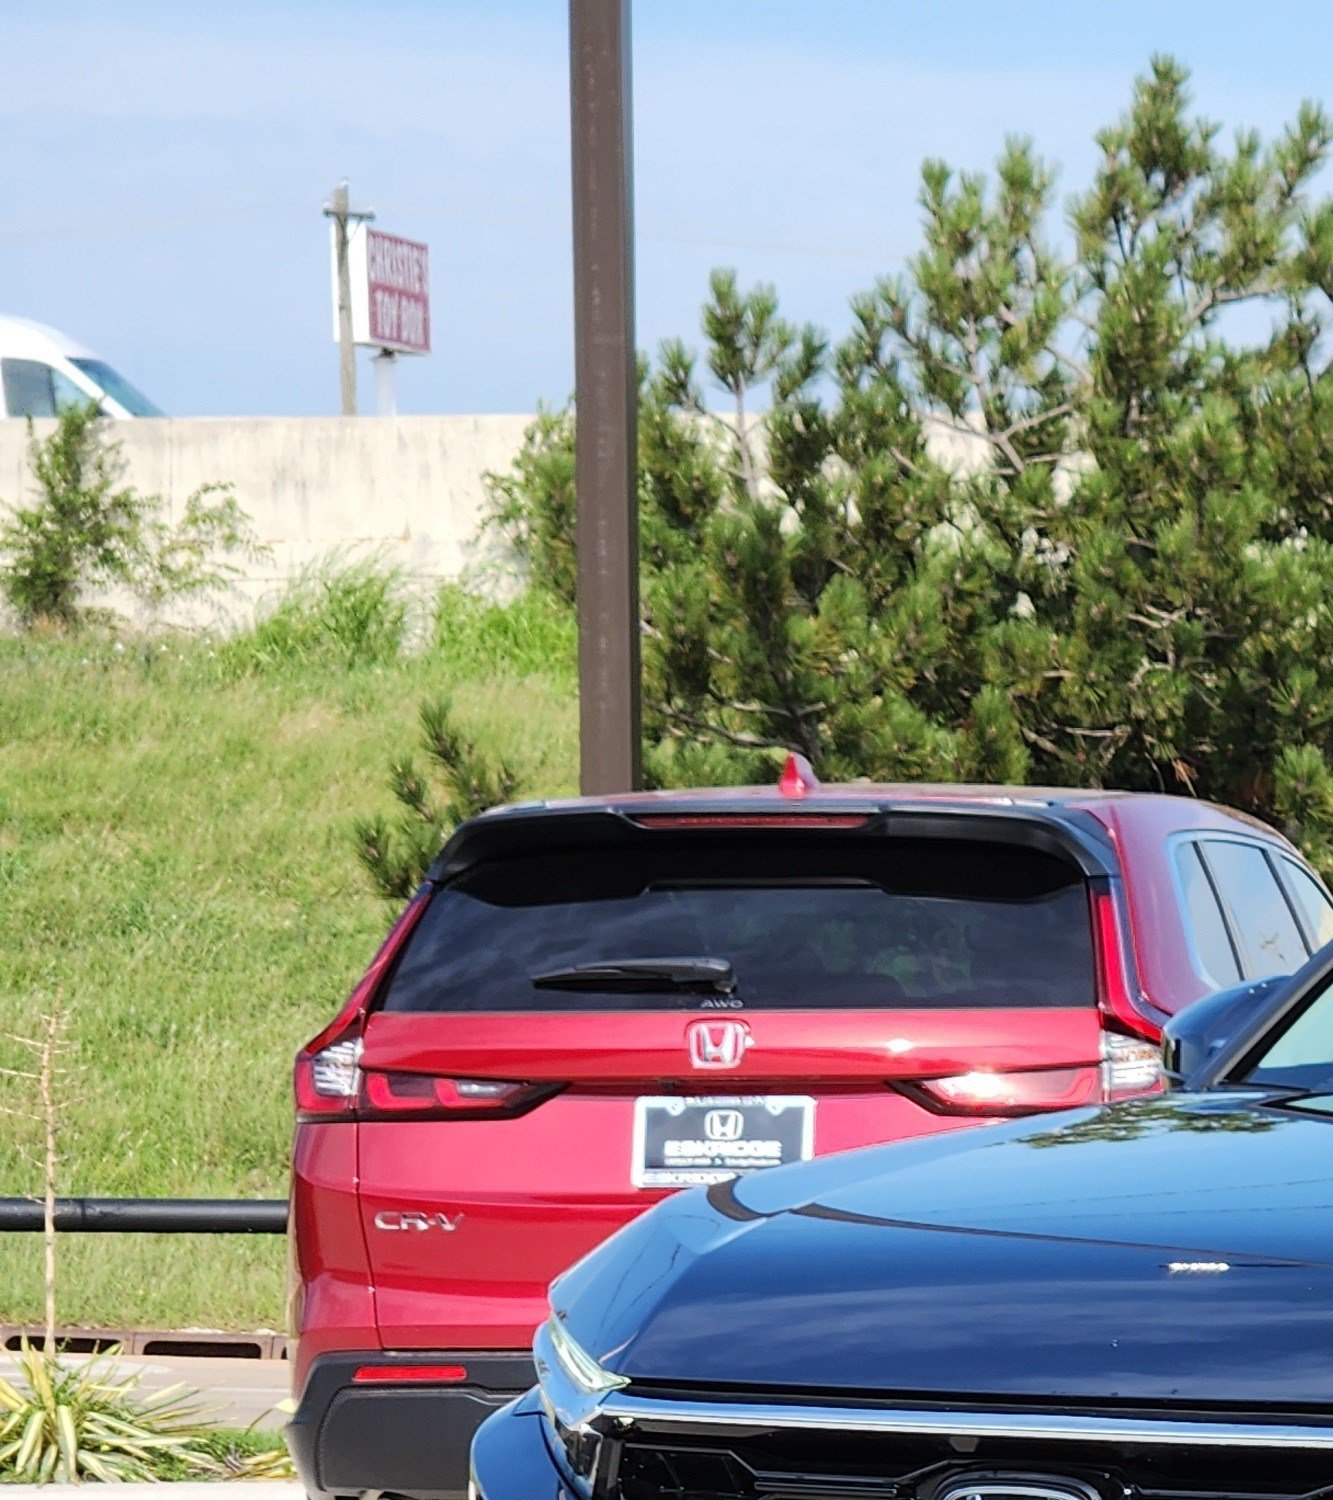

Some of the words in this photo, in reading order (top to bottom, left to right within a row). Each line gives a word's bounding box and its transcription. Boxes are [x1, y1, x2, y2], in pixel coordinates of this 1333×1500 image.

[375, 289, 398, 339] TOY
[401, 295, 424, 345] BOX
[701, 999, 743, 1009] AWD
[664, 1140, 782, 1158] ESKRIDGE
[374, 1211, 465, 1231] CR-V
